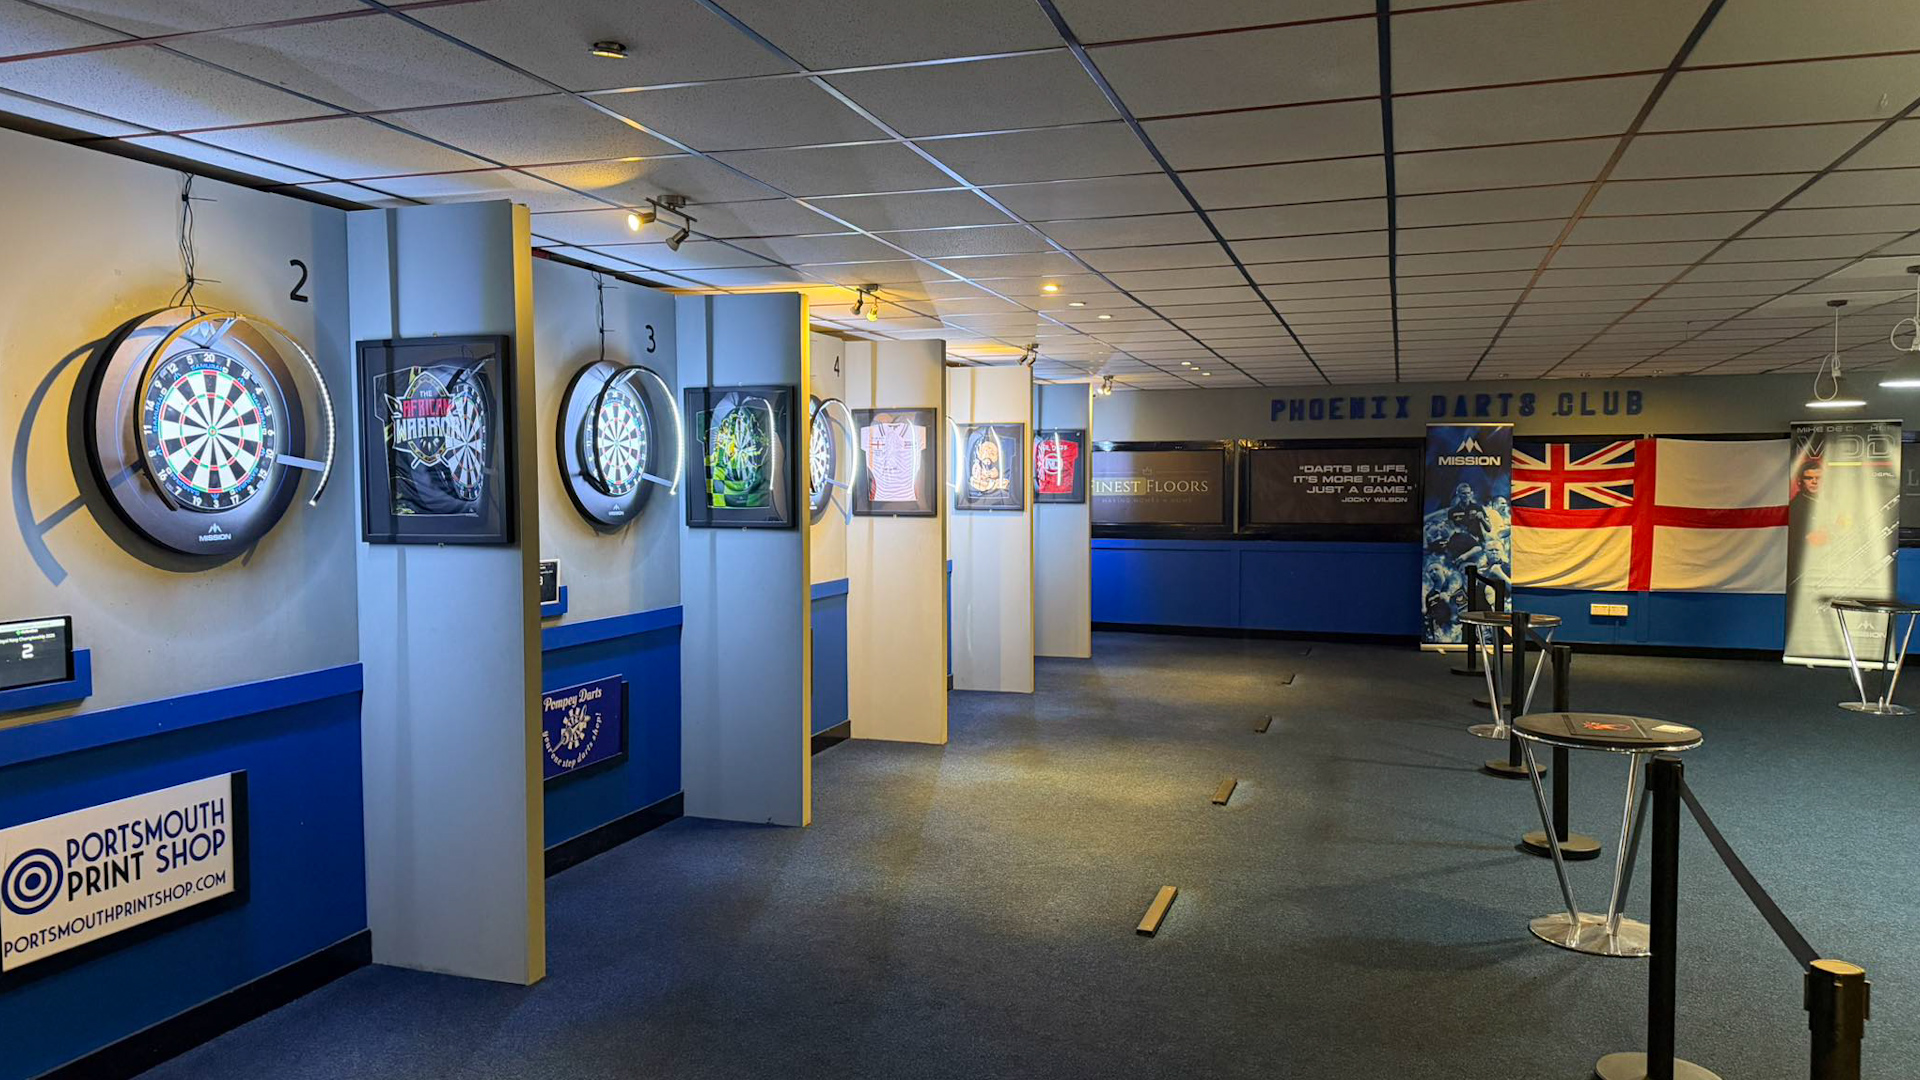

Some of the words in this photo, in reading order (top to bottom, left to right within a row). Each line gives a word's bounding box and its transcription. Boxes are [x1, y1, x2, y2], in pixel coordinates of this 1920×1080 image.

[290, 259, 308, 303] 2
[645, 324, 656, 353] 3
[204, 353, 215, 363] 20
[226, 358, 232, 368] 1
[167, 362, 179, 374] 12
[833, 355, 840, 378] 4
[420, 390, 432, 398] THE
[1271, 396, 1411, 421] PHOENIX
[1430, 392, 1535, 418] DARTS
[1556, 390, 1644, 416] CLUB
[143, 425, 152, 435] 11
[1438, 456, 1501, 466] MISSION
[1356, 464, 1370, 473] IS
[1374, 464, 1408, 474] LIFE,
[1293, 475, 1318, 483] IT'S
[1322, 475, 1363, 483] MORE
[1367, 475, 1408, 483] THAN
[1306, 485, 1344, 494] JUST
[1348, 485, 1359, 494] A
[230, 494, 240, 505] 17
[198, 533, 232, 541] MISSION
[22, 643, 35, 659] 2
[543, 694, 578, 712] Pompey
[579, 686, 603, 703] Darts
[66, 798, 225, 869] PORTSMOUTH
[68, 851, 144, 901] PRINT
[156, 828, 226, 873] SHOP
[4, 870, 226, 958] PORTSMOUTHPRINTSHOP.COM
